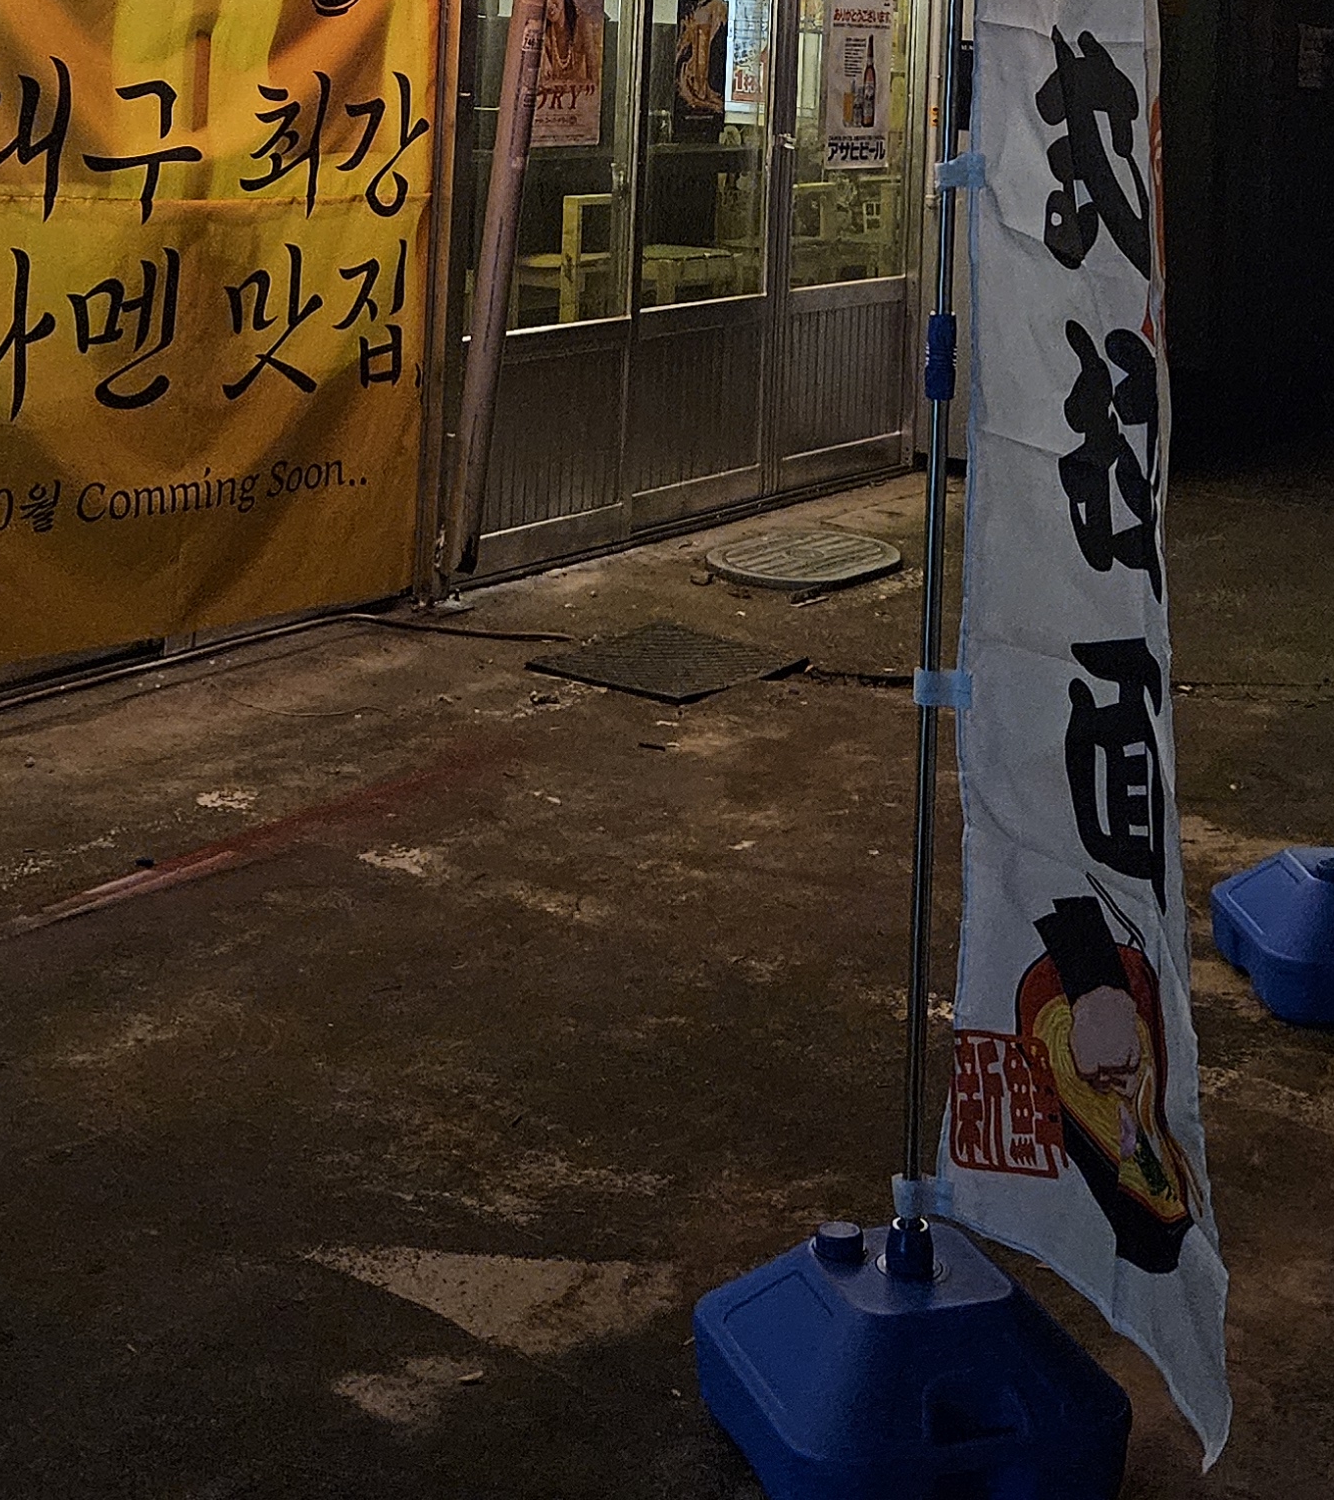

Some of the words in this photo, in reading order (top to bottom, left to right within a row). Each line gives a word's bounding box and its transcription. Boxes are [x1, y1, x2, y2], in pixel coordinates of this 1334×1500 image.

[239, 70, 430, 218] 최강
[827, 141, 886, 161] アサヒビール
[76, 466, 259, 524] Comming
